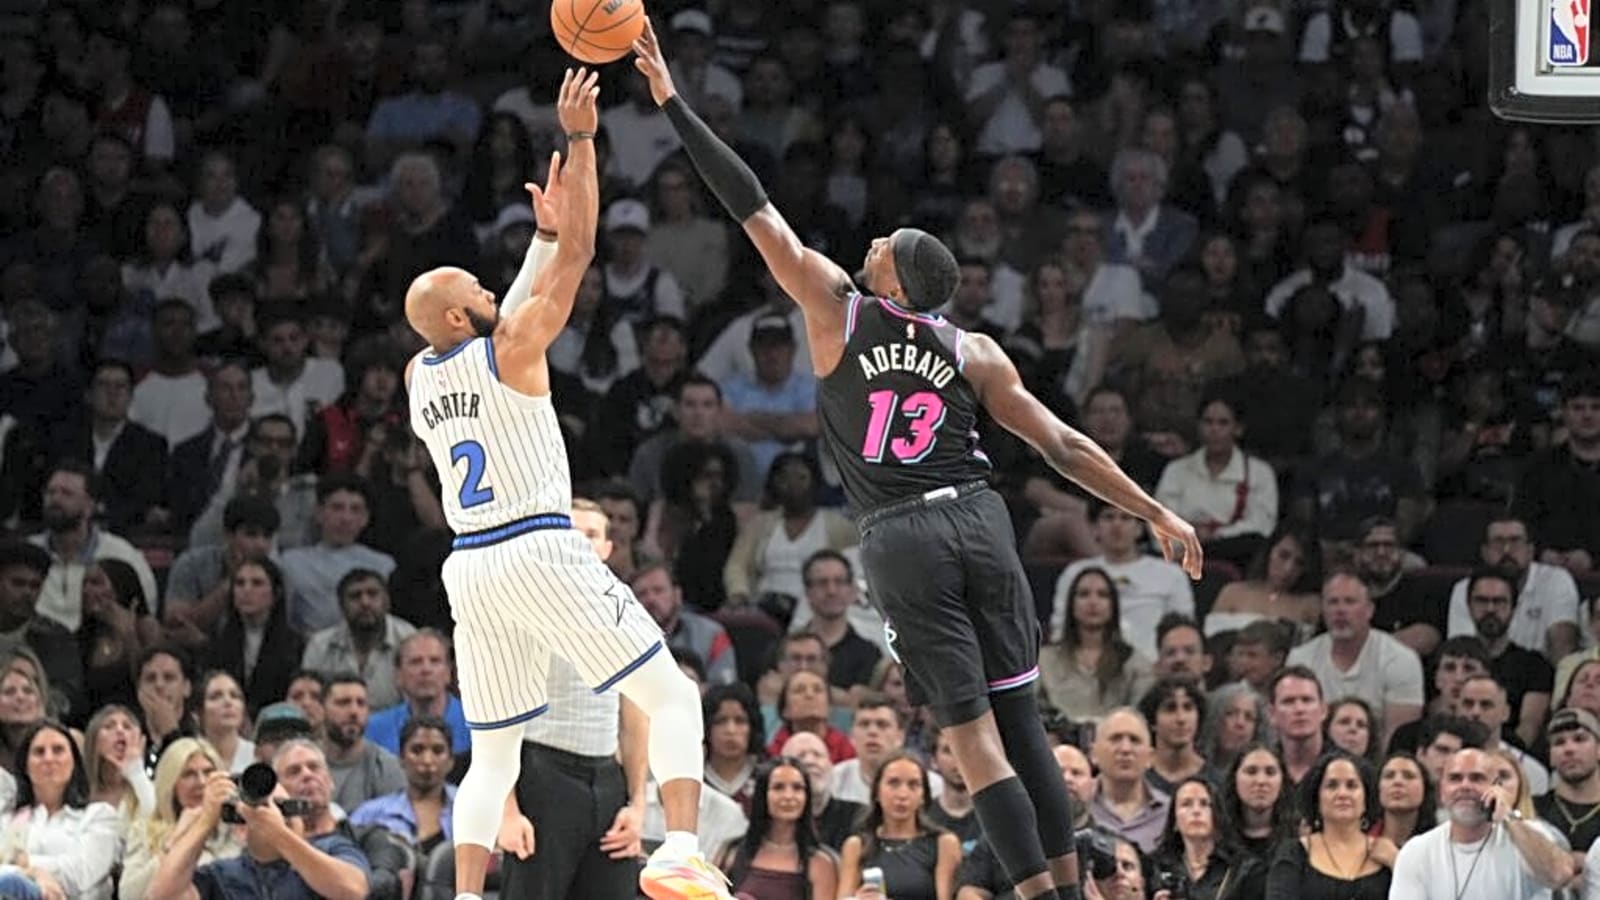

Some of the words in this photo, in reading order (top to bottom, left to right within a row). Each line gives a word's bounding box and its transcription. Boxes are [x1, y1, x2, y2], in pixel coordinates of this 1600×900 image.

[1553, 44, 1573, 60] NBA
[858, 343, 955, 389] ADEBAYO
[422, 392, 480, 430] CARTER
[861, 389, 947, 464] 13
[450, 440, 495, 509] 2
